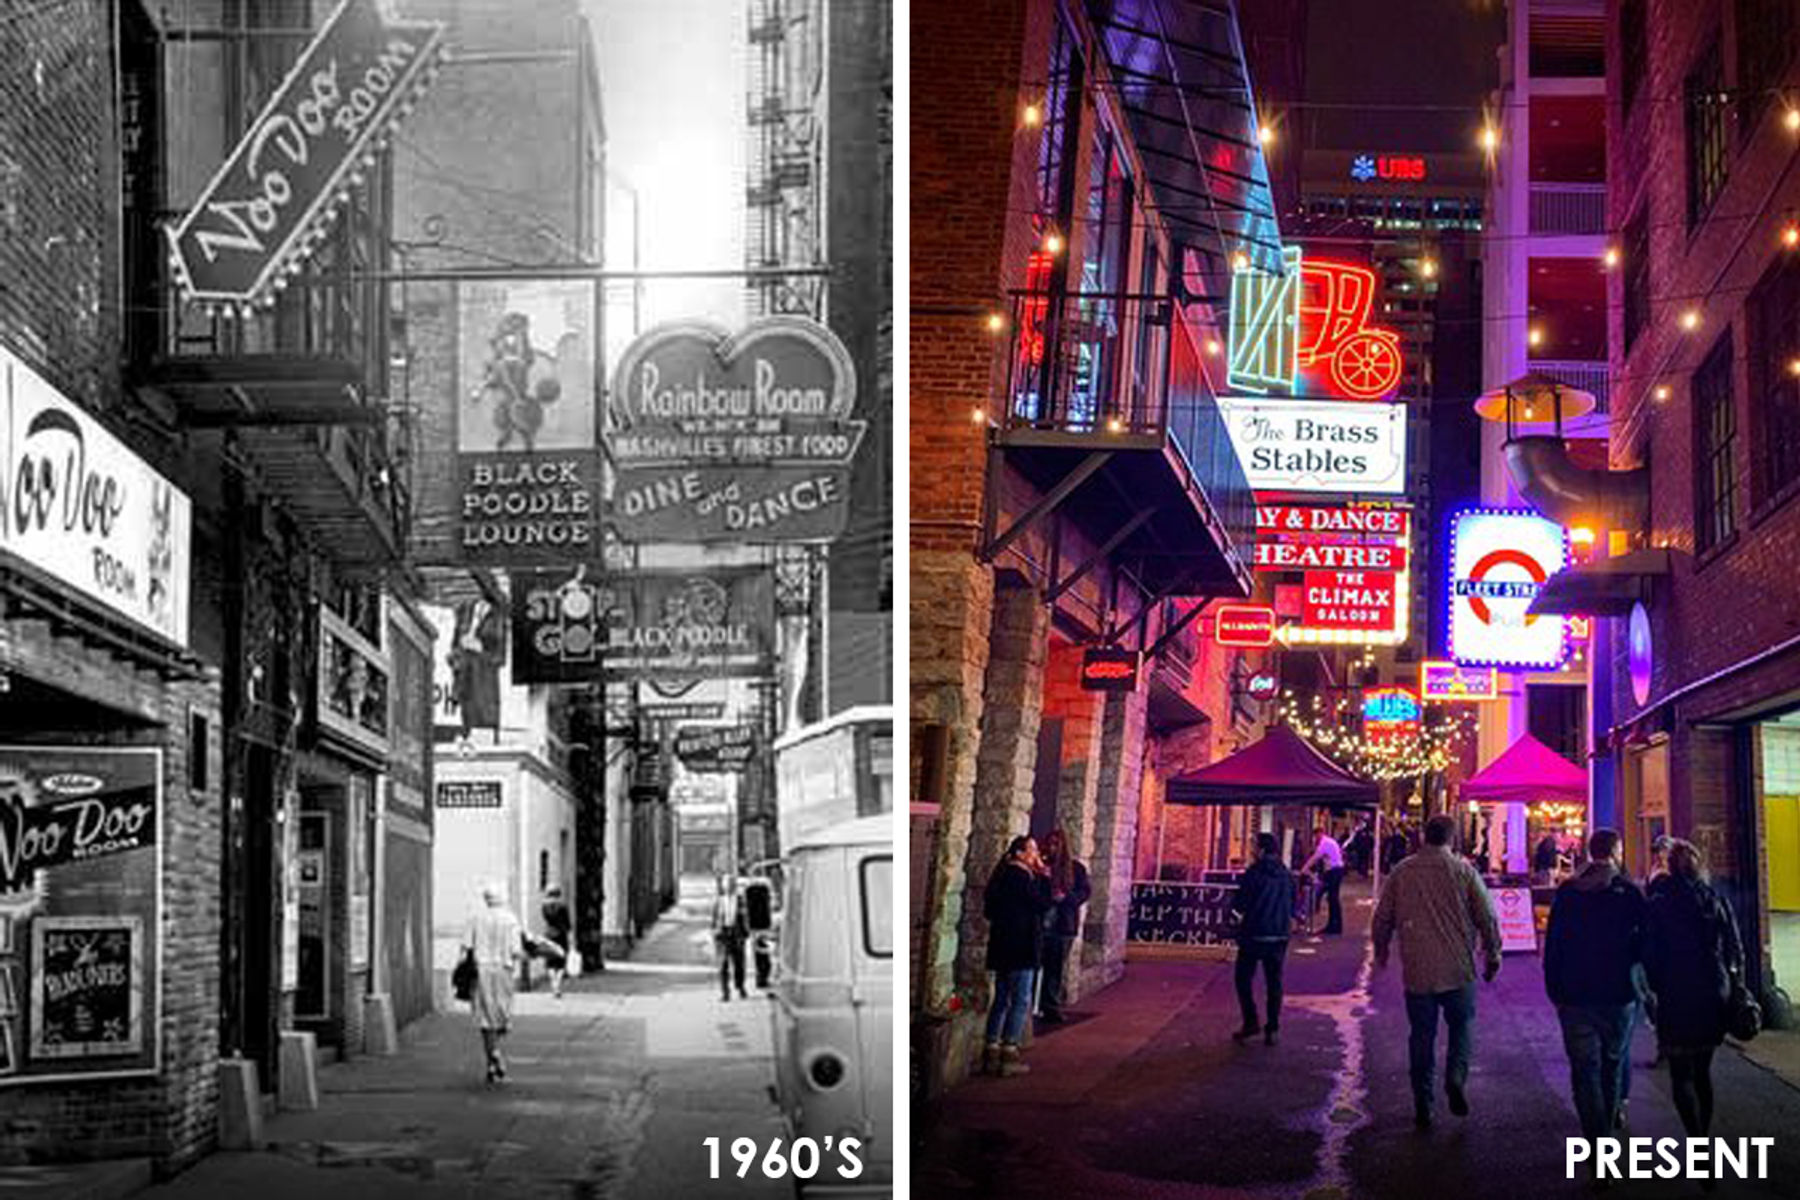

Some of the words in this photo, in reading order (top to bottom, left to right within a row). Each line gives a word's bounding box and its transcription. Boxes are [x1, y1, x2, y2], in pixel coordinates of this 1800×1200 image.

[333, 40, 416, 143] ROOM
[1377, 154, 1426, 179] UBS
[641, 360, 750, 417] Rainbow
[755, 359, 825, 416] Room
[1240, 414, 1285, 443] The
[1295, 418, 1380, 444] Brass
[1250, 447, 1368, 474] Stables
[473, 461, 582, 487] BLACK
[463, 491, 590, 516] POODLE
[624, 472, 703, 517] DINE
[698, 482, 740, 516] and
[726, 476, 839, 530] DANCE
[1256, 507, 1281, 528] AY
[1285, 508, 1304, 529] &
[1310, 508, 1401, 532] DANCE
[463, 521, 590, 546] LOUNGE
[1254, 543, 1391, 567] HEATRE
[1336, 572, 1365, 586] THE
[1308, 587, 1390, 607] CLIMAX
[1317, 608, 1381, 621] SALOON
[52, 799, 151, 846] Doo
